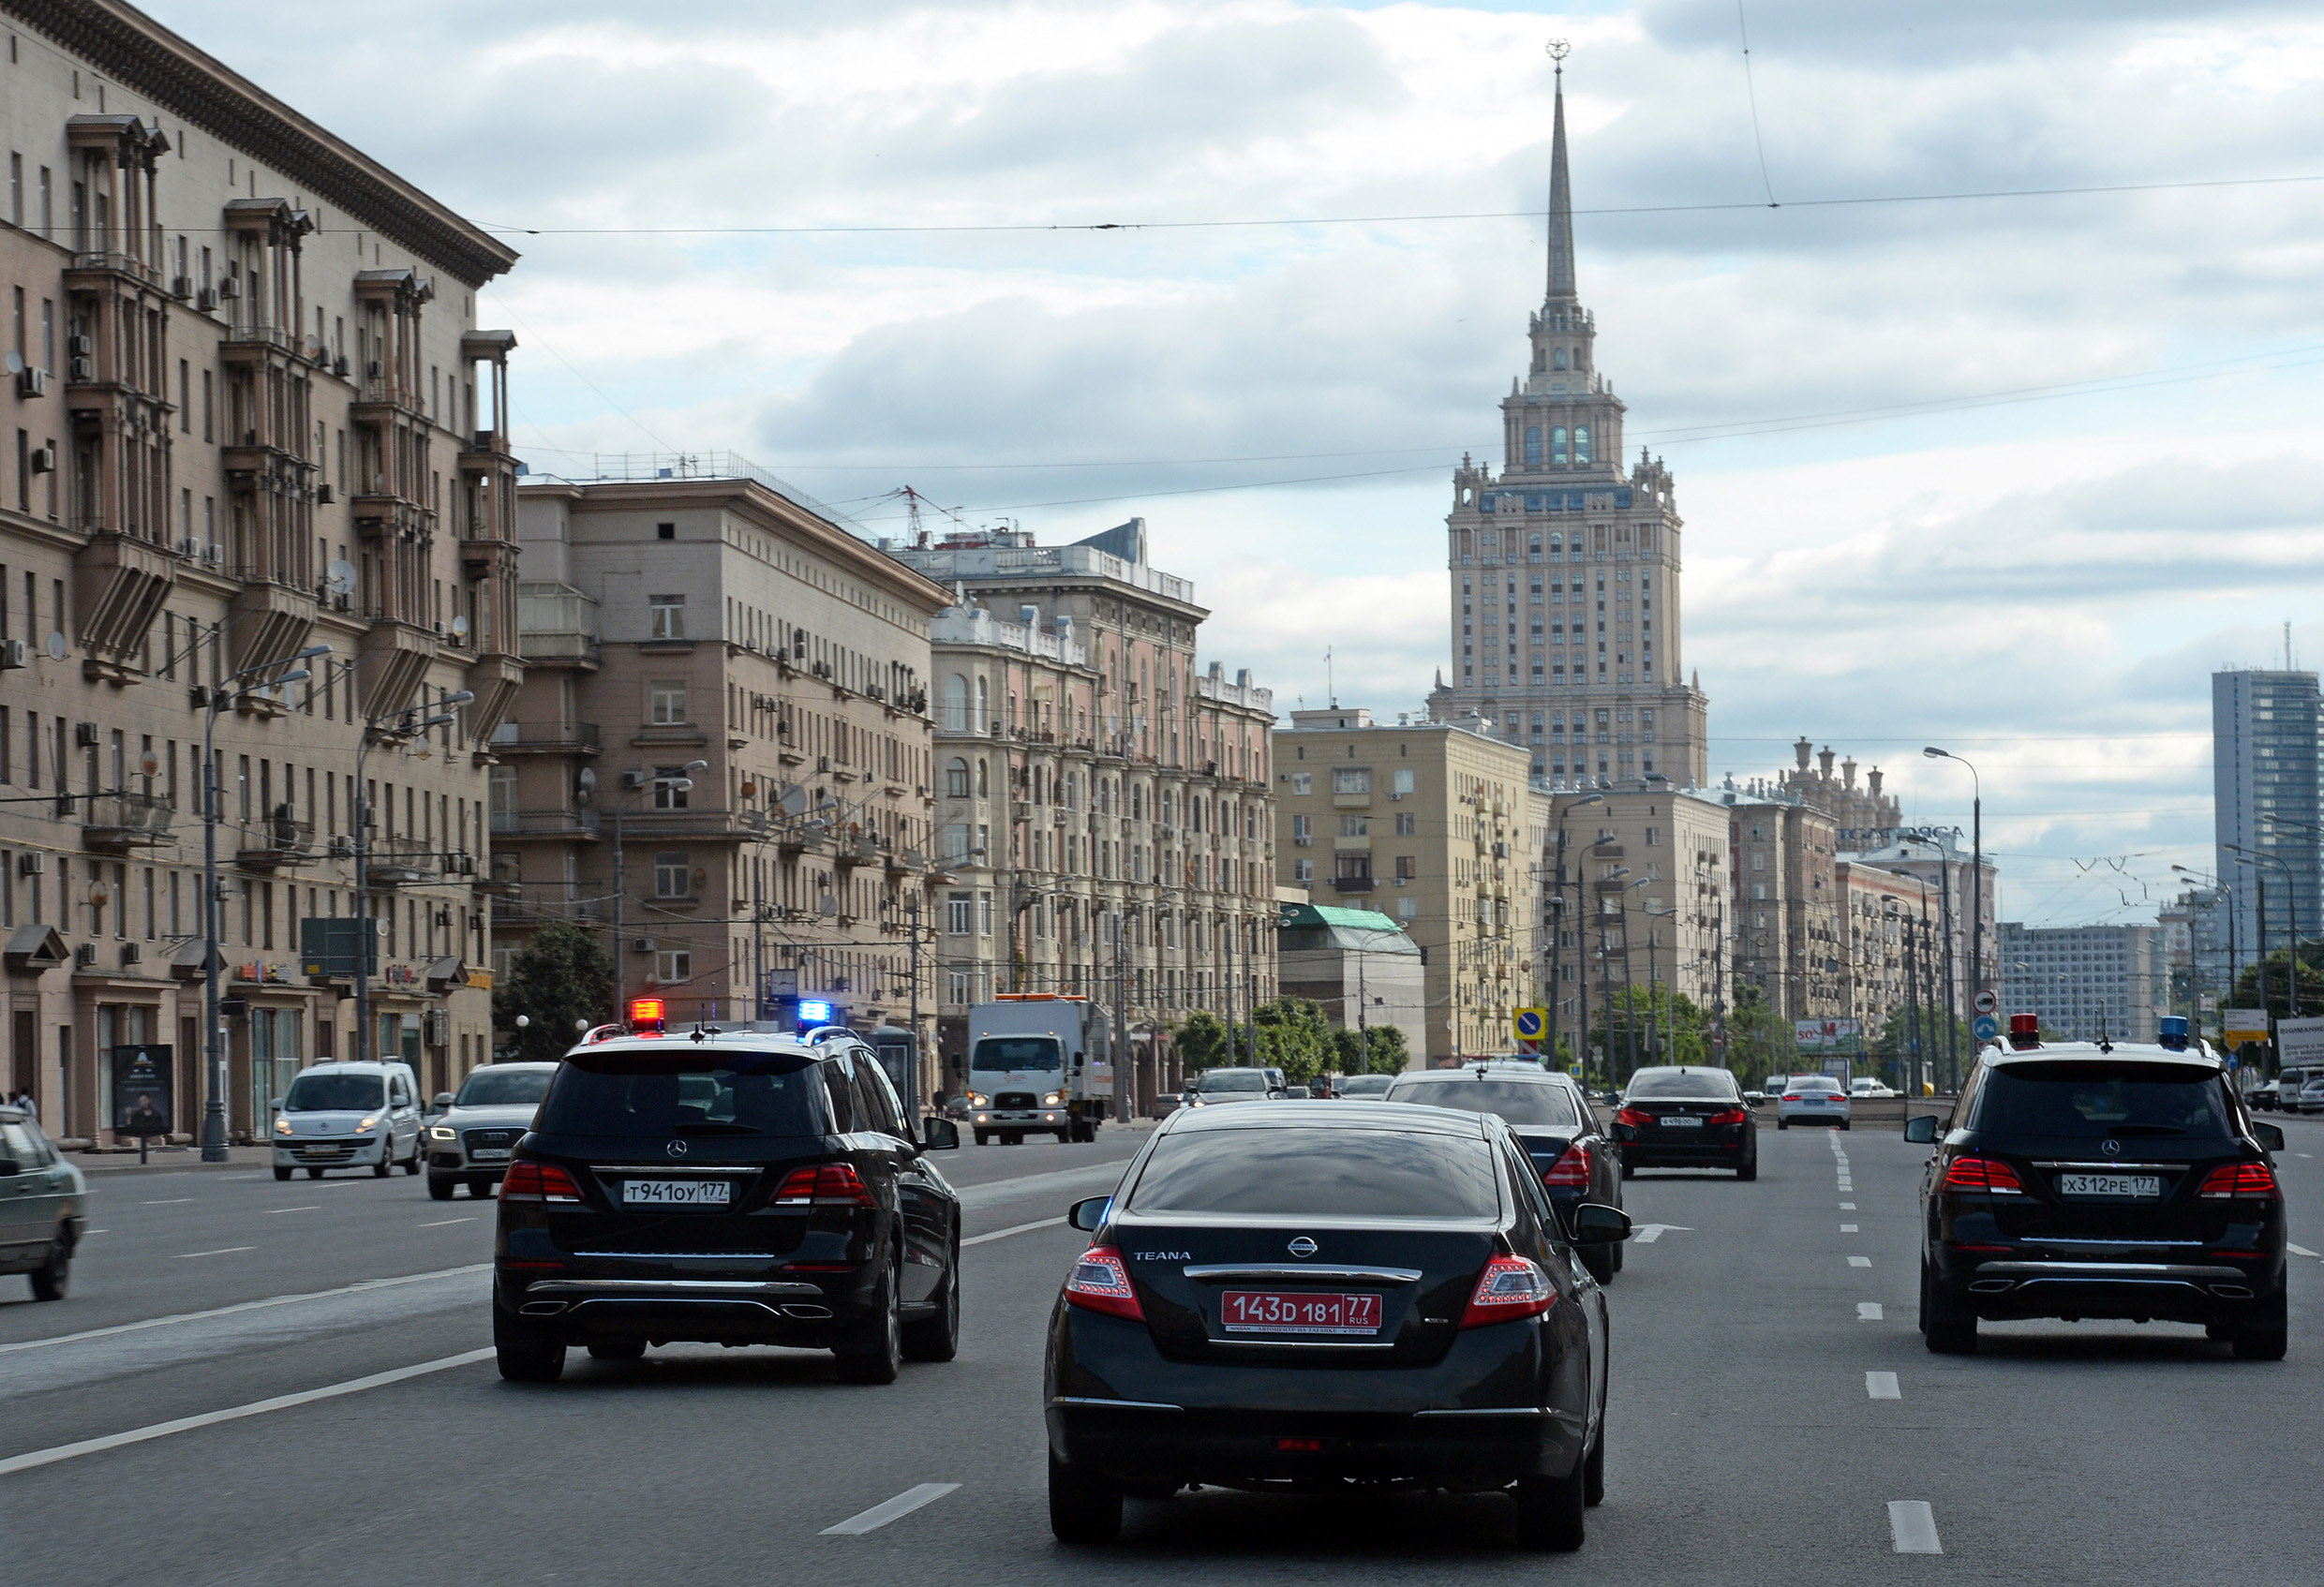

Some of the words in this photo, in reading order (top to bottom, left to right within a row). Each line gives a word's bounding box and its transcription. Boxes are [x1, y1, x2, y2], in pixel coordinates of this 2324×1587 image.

[700, 1183, 725, 1196] 177
[2132, 1177, 2155, 1190] 177
[1134, 1251, 1191, 1261] TEANA
[1347, 1297, 1373, 1317] 77
